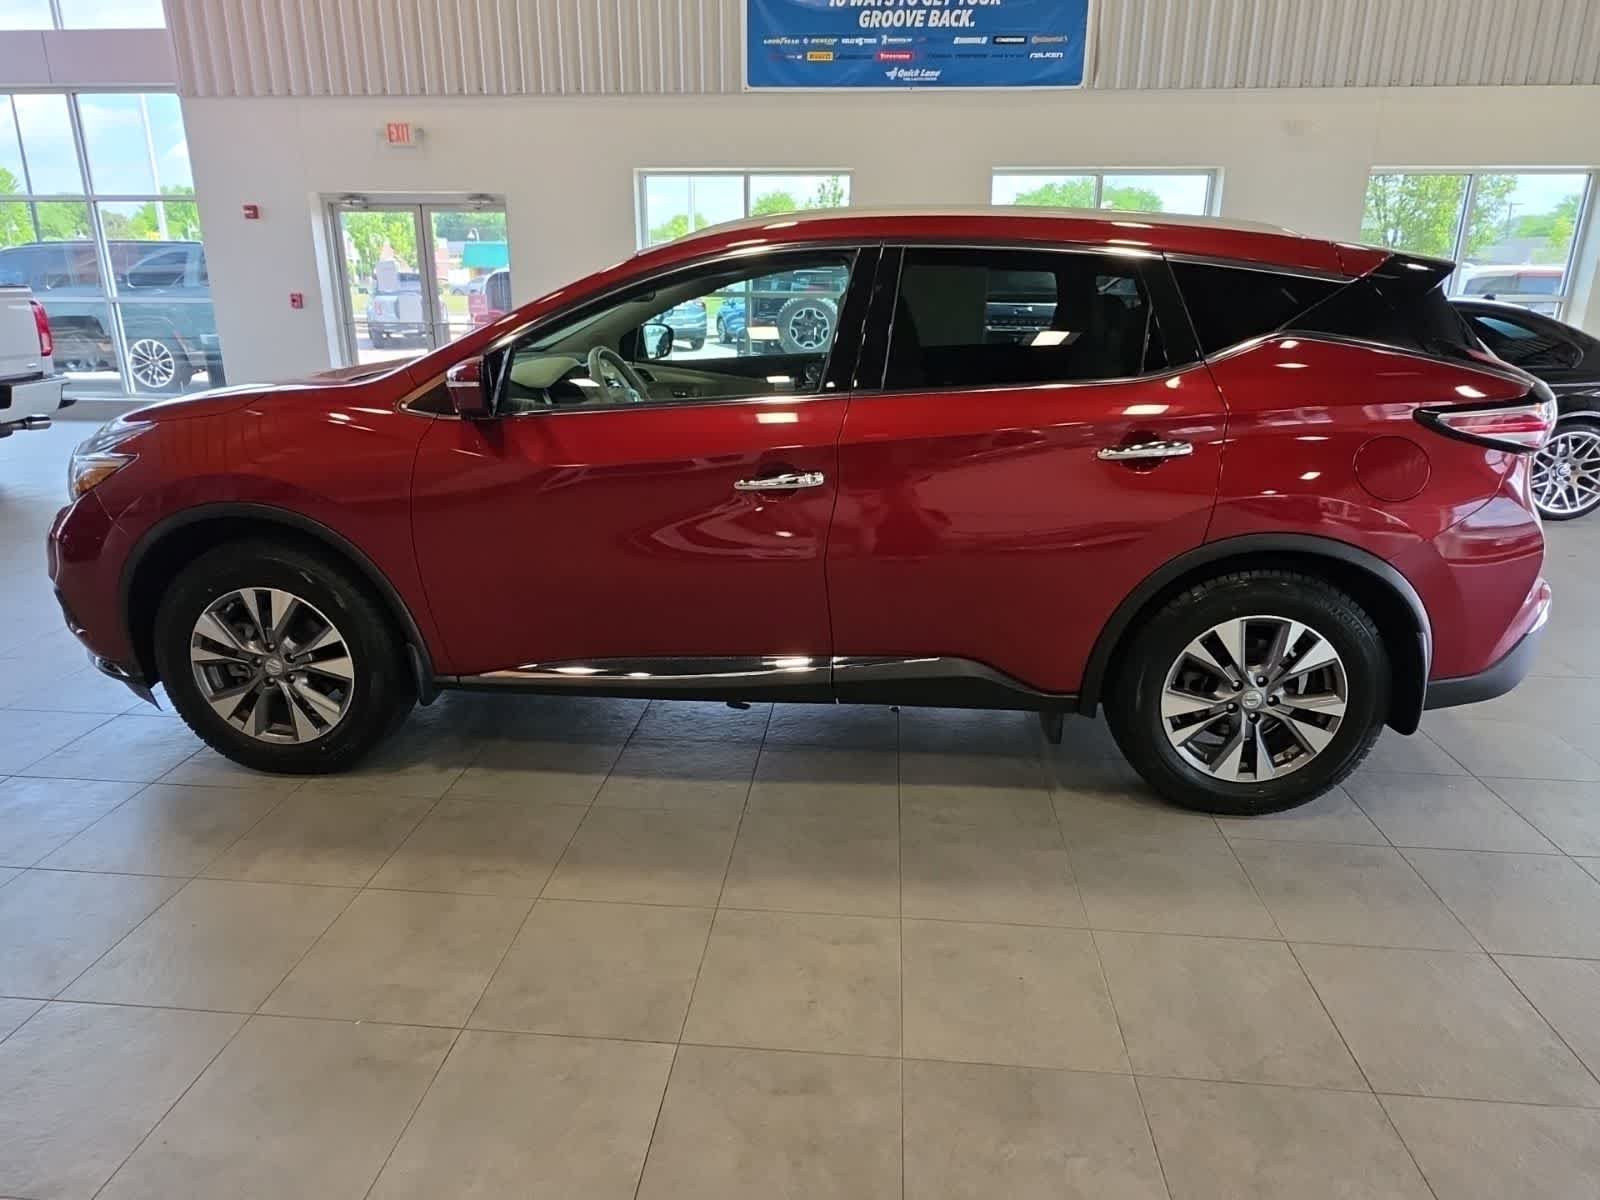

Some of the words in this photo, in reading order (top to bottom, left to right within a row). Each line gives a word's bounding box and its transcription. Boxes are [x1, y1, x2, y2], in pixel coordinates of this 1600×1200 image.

[859, 10, 926, 28] GROOVE
[928, 9, 976, 28] BACK.
[897, 68, 920, 78] Quick
[920, 68, 941, 77] Lane
[387, 122, 409, 143] EXIT
